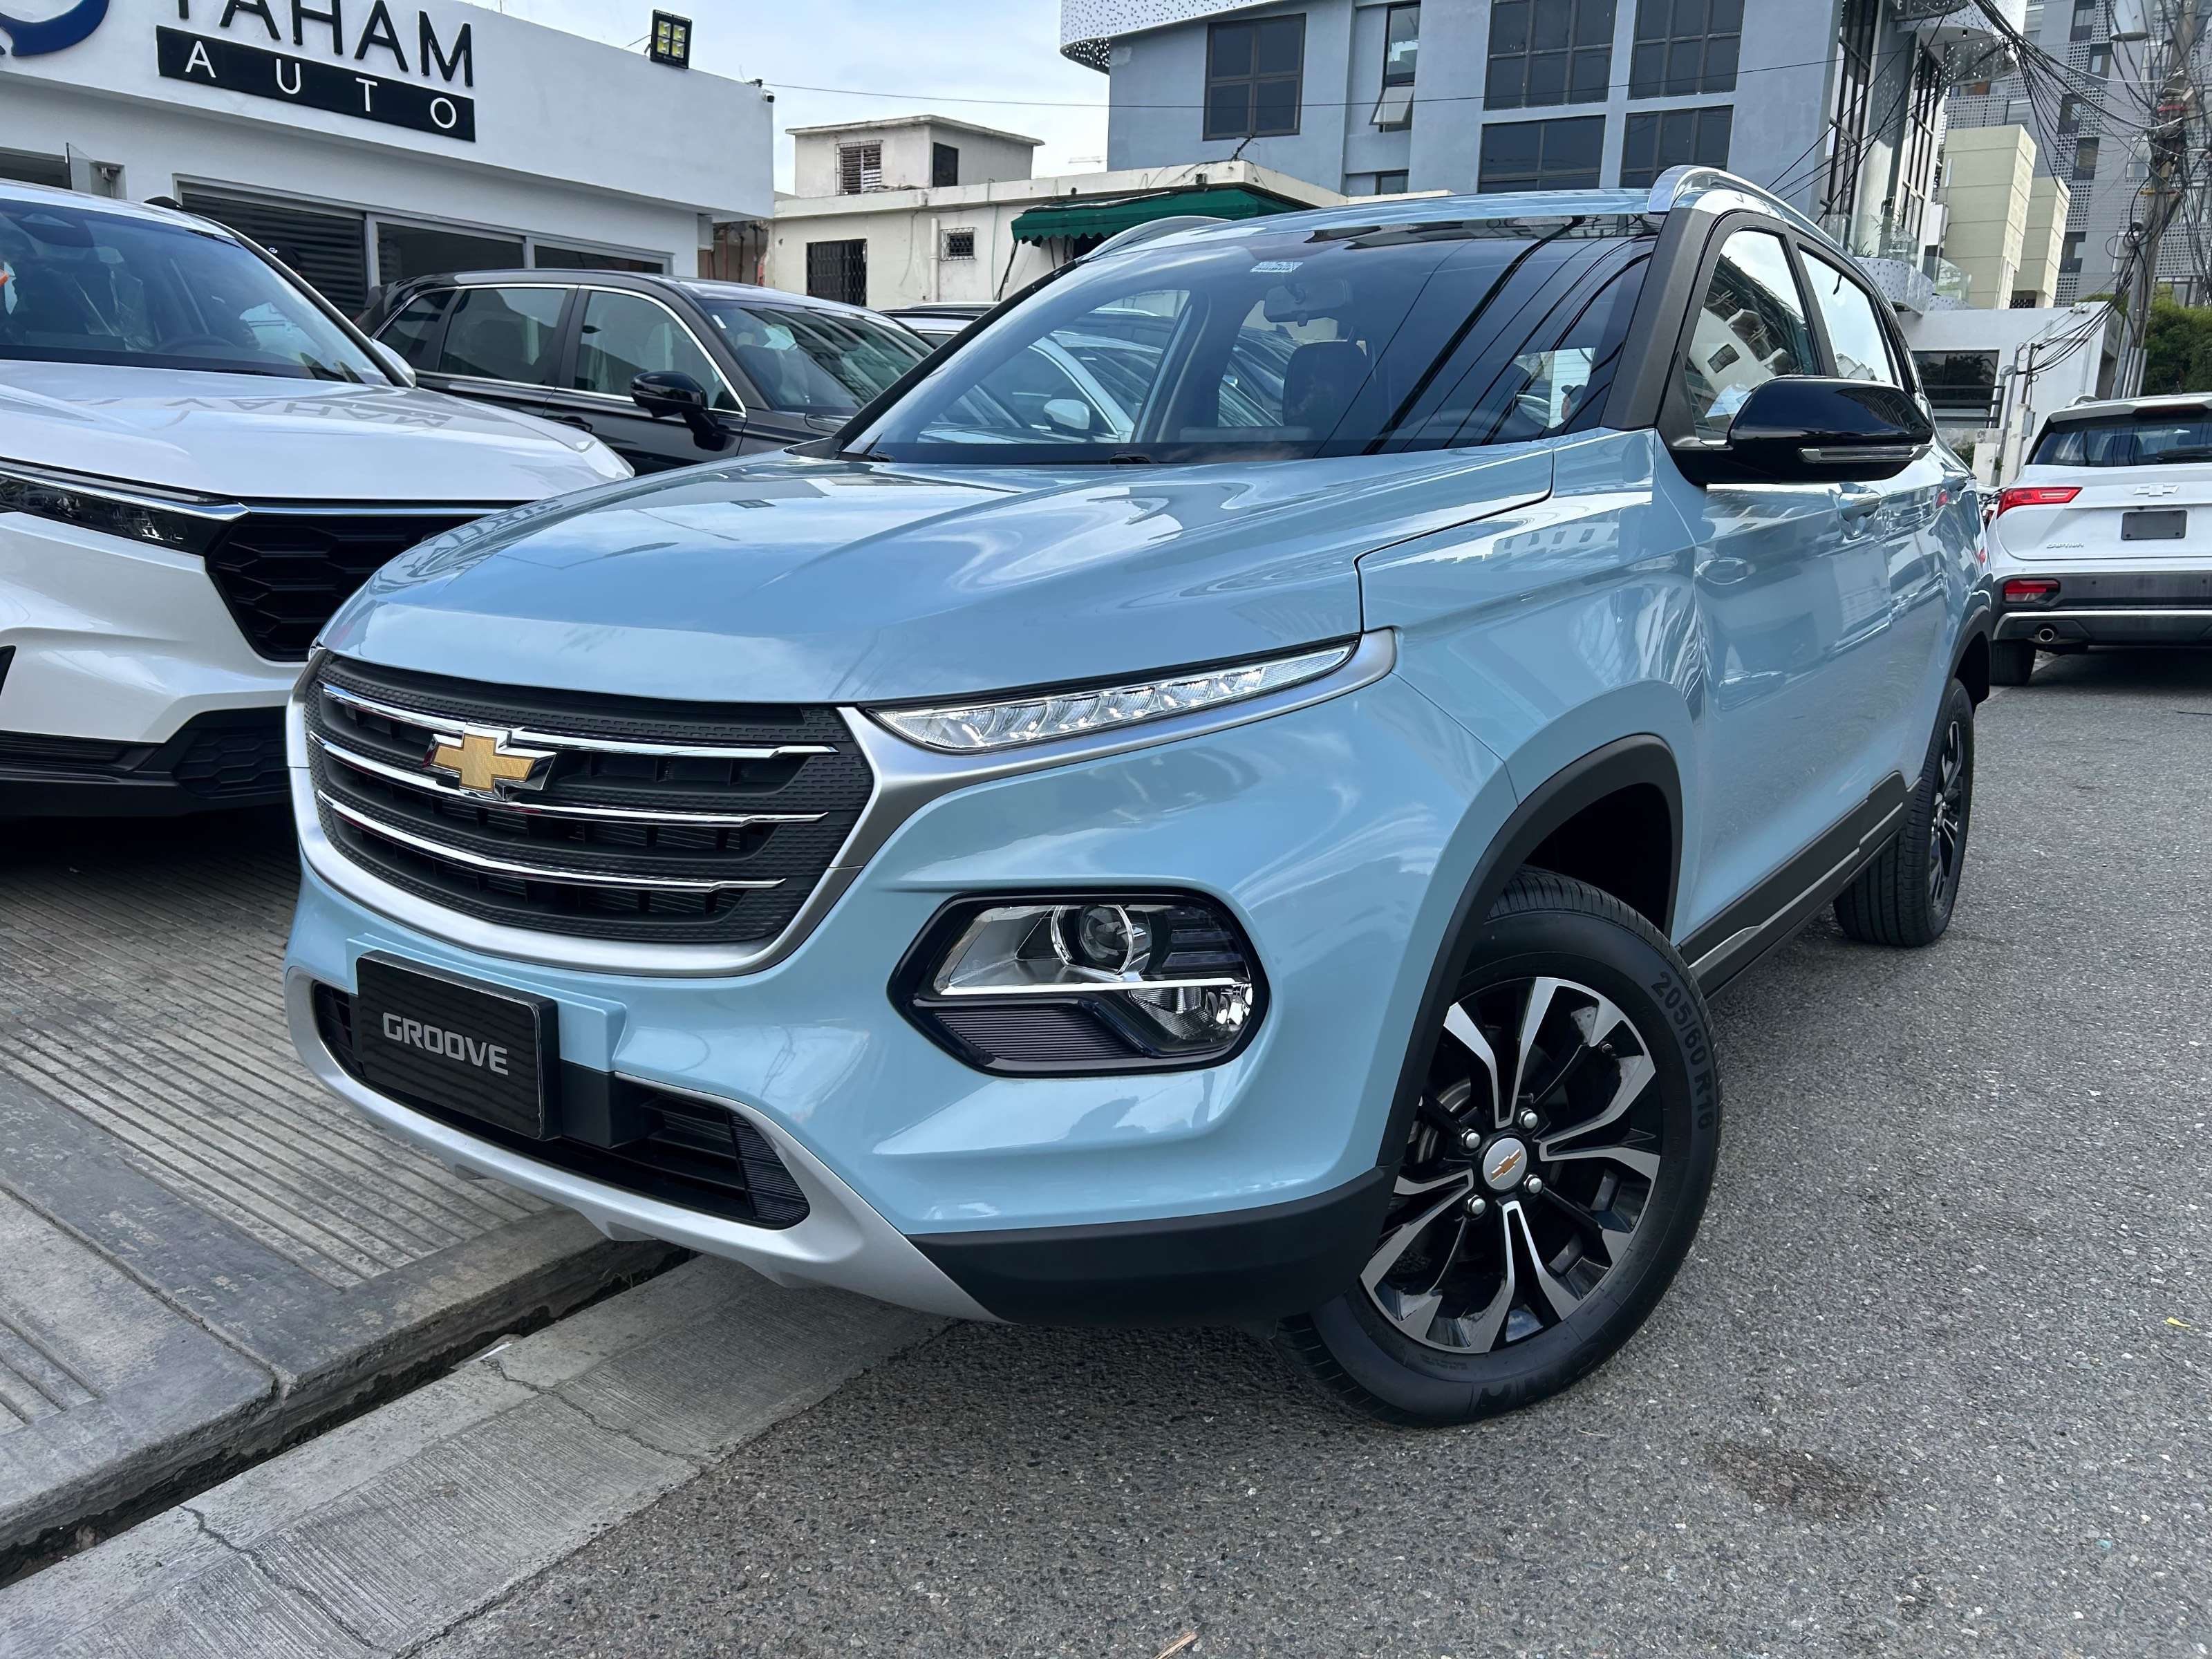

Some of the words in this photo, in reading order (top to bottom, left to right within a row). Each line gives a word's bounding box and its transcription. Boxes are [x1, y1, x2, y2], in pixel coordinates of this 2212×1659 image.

[178, 0, 474, 87] AHAM
[185, 40, 457, 129] AUTO
[382, 1011, 509, 1076] GROOVE
[1651, 971, 1707, 1065] 205/60
